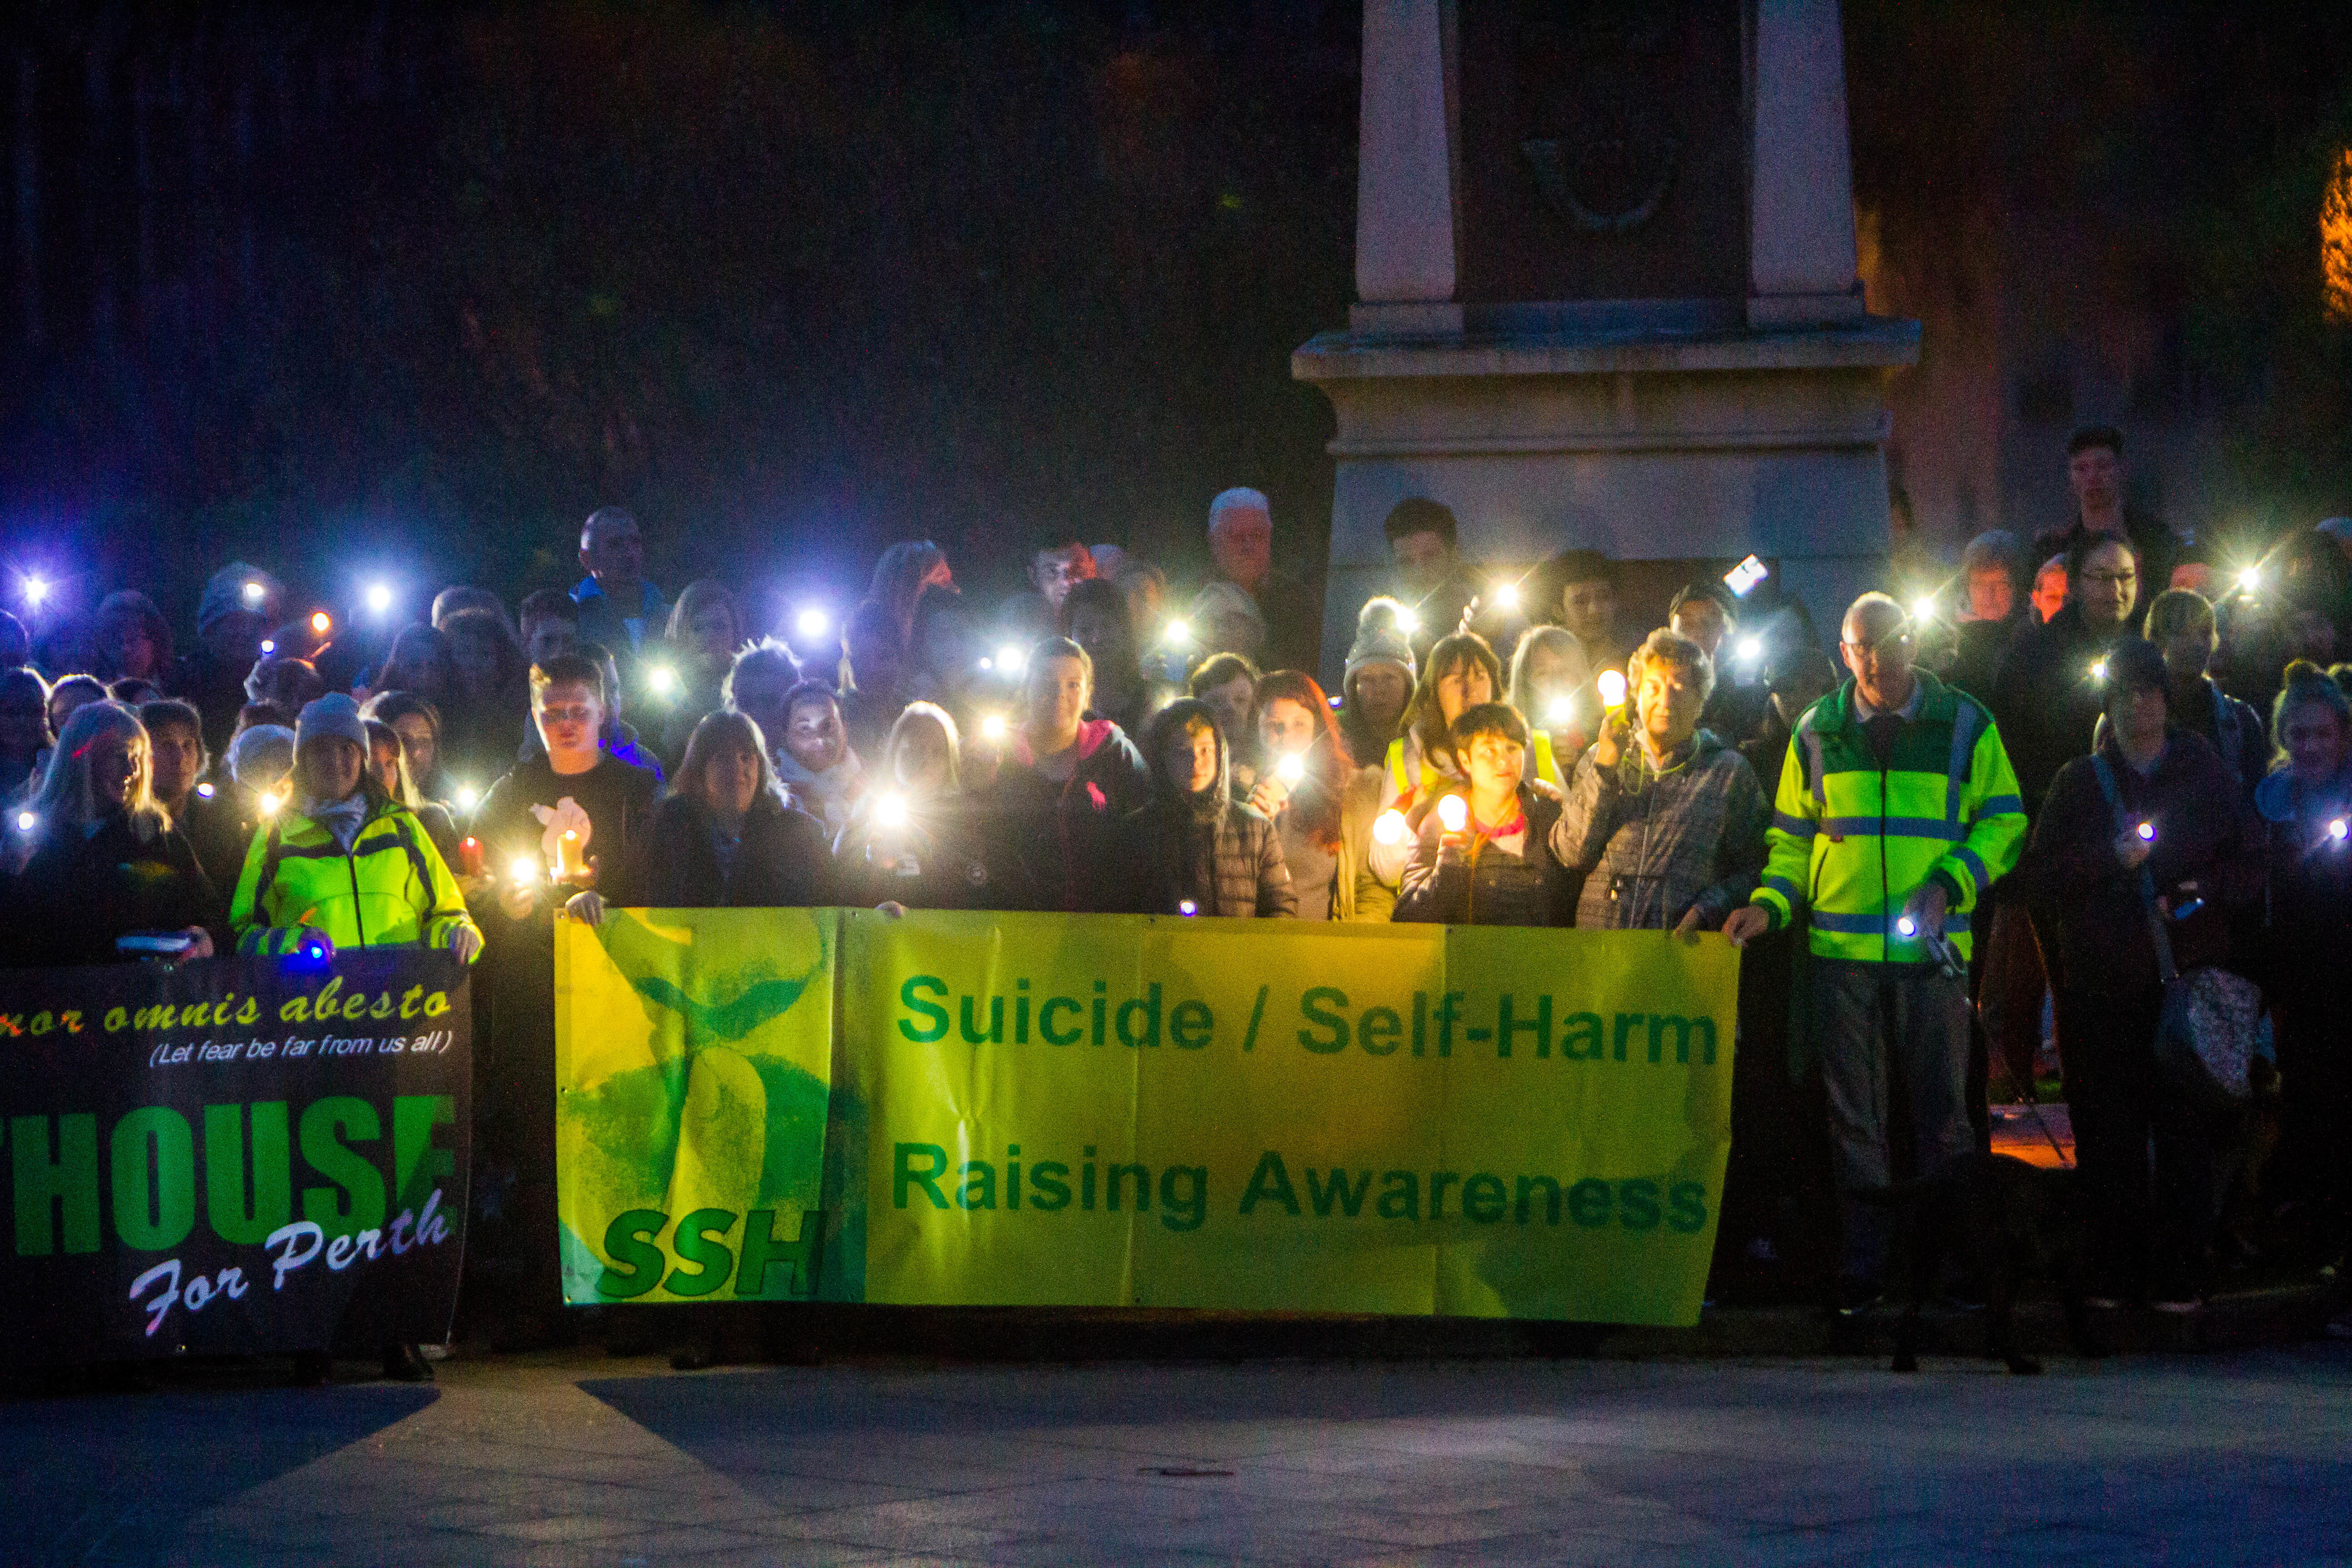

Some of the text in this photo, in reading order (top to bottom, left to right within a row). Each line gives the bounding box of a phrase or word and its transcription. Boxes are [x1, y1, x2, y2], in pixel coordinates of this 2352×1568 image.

[104, 992, 261, 1030] omnis
[279, 976, 451, 1020] abesto
[898, 975, 1718, 1064] Suicide / Self-Harm
[150, 1030, 453, 1068] (Let fear be far from us all)
[0, 1095, 456, 1257] HOUSE
[893, 1142, 1707, 1233] Raising Awareness
[129, 1188, 449, 1337] For Perth
[598, 1208, 828, 1298] SSH
